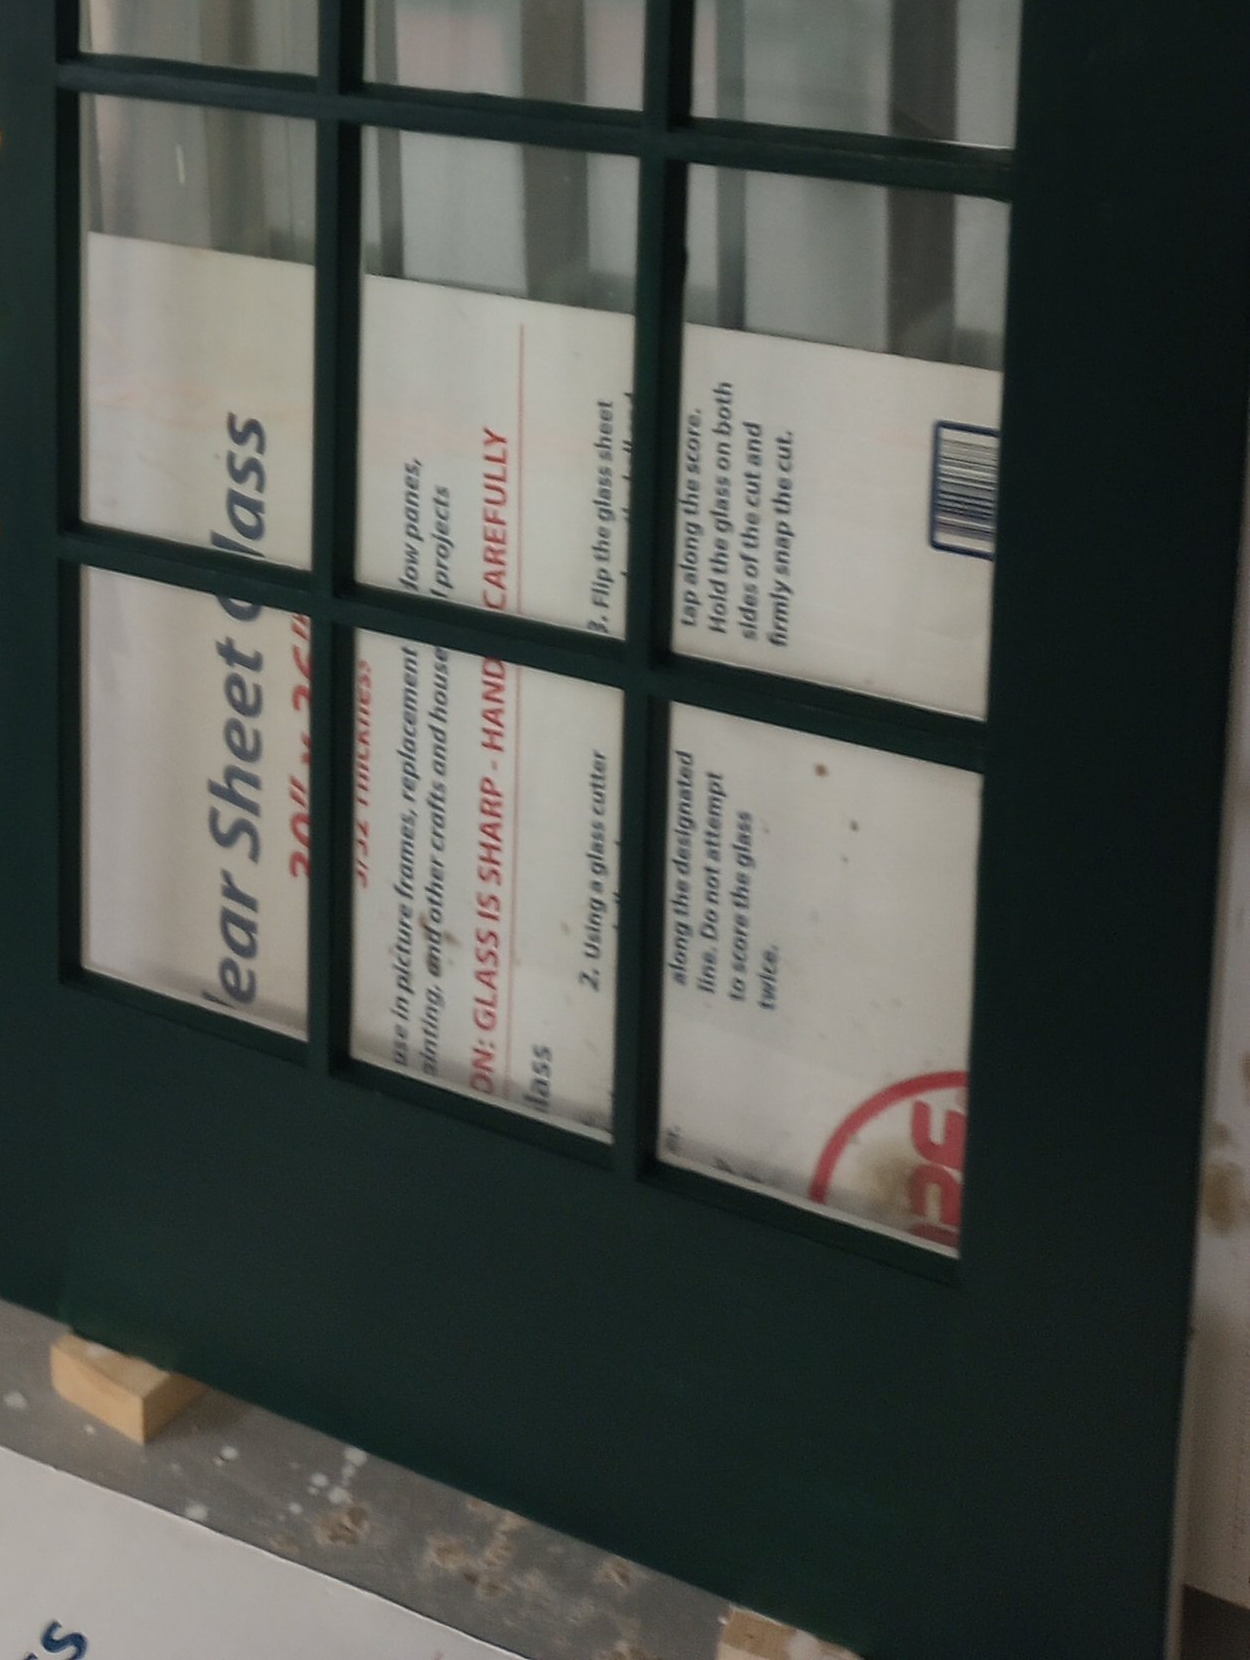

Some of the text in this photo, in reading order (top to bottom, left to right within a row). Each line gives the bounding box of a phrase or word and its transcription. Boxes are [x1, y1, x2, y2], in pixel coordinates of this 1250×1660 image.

[593, 400, 613, 462] sheet
[404, 458, 424, 543] panes,
[429, 485, 454, 589] projects
[483, 426, 507, 610] CAREFULLY
[591, 519, 611, 562] the
[592, 466, 615, 523] glass
[680, 408, 703, 627] tap along the score.
[708, 382, 733, 634] Hold the glass on both
[738, 421, 763, 641] sides of the cut and
[768, 431, 795, 647] firmly snap the cut.
[591, 566, 614, 609] Flip
[397, 646, 420, 802] replacement
[428, 721, 448, 776] and
[481, 656, 505, 753] HAND
[208, 637, 264, 865] Sheet
[393, 807, 418, 899] frames,
[425, 782, 446, 853] crafts
[477, 776, 503, 886] SHARP
[424, 854, 444, 924] other
[476, 891, 501, 921] IS
[578, 750, 607, 992] 2. Using a glass cutter
[668, 750, 696, 986] along the designated
[697, 771, 727, 994] line. Do not attempt
[728, 809, 756, 1001] to score the glass
[392, 905, 415, 995] picture
[423, 924, 442, 977] and
[473, 927, 499, 1032] GLASS
[758, 943, 779, 1010] twice.
[391, 996, 410, 1021] in
[394, 1024, 409, 1066] use
[521, 1043, 552, 1108] lass
